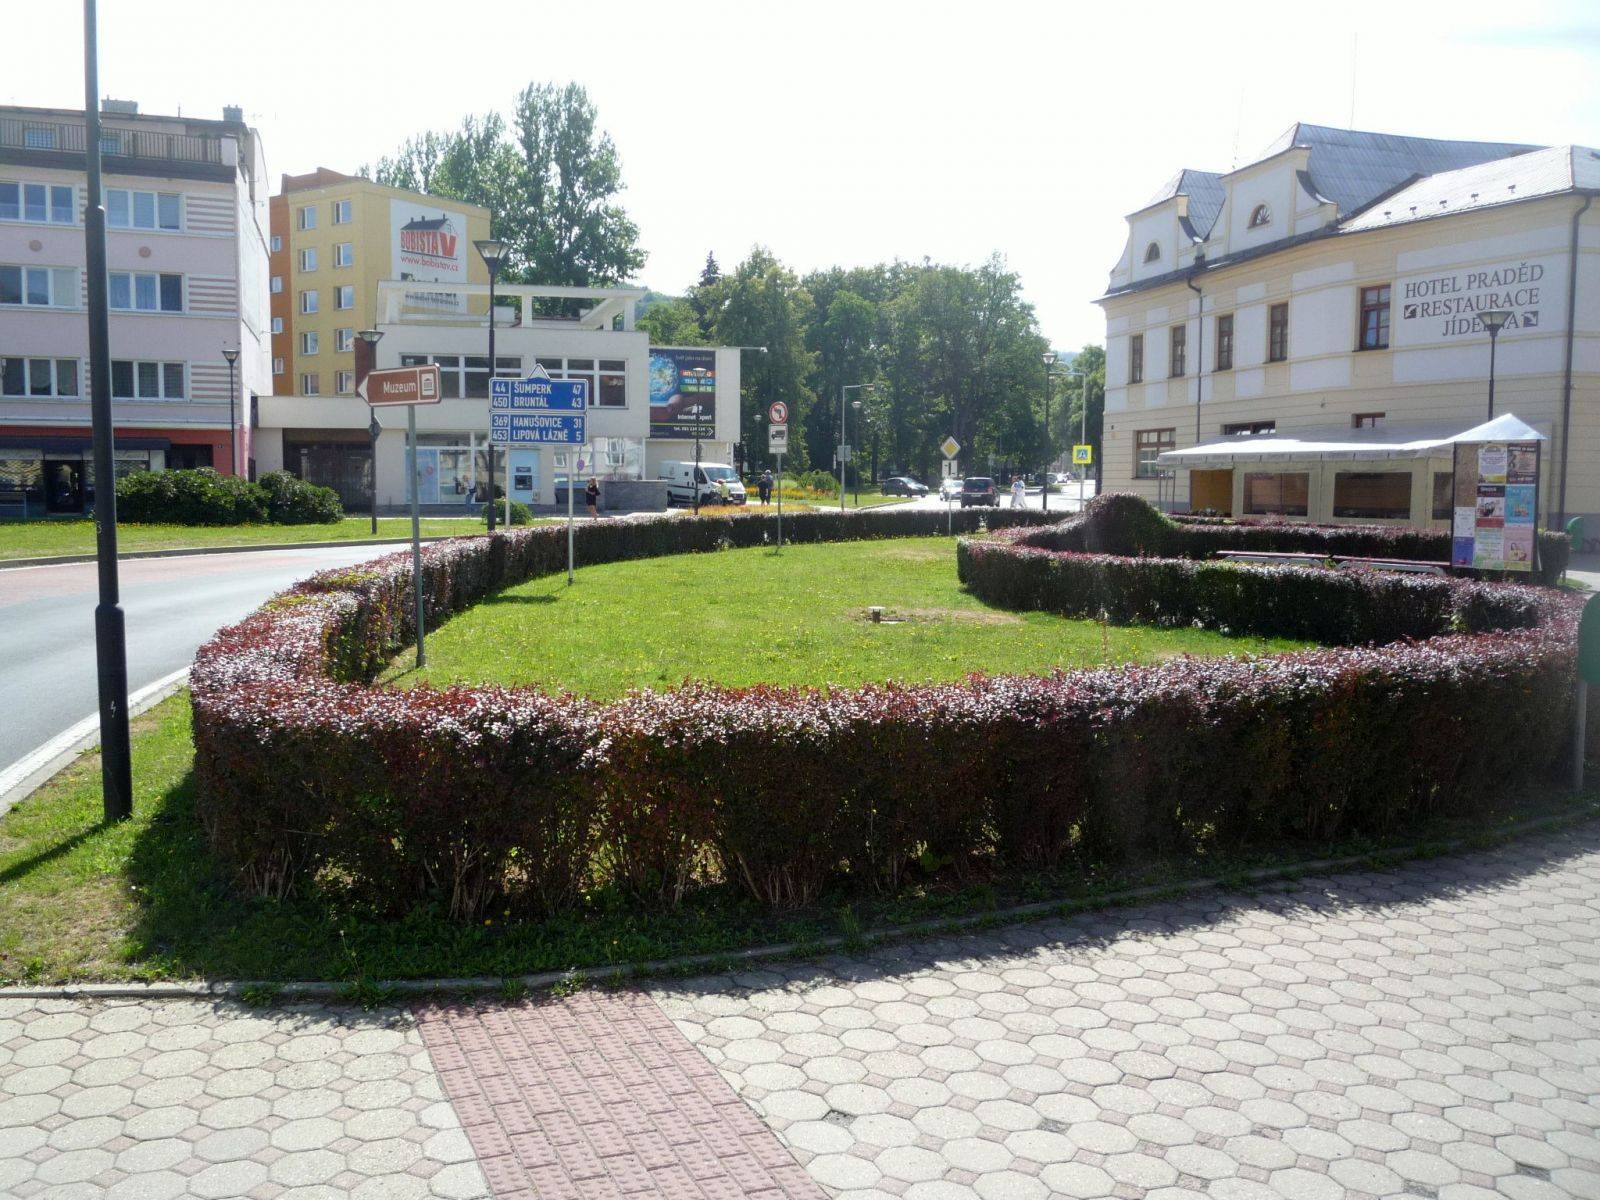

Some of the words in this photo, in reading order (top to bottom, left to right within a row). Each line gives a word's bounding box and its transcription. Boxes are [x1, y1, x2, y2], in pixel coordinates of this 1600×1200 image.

[401, 230, 456, 257] BOBISTAV
[1404, 276, 1462, 299] HOTEL
[1467, 262, 1544, 291] PRADĚD
[1420, 287, 1540, 318] RESTAURACE
[1442, 312, 1521, 337] JÍDEA
[383, 381, 417, 394] Muzeum
[495, 383, 506, 393] 44
[514, 382, 552, 394] ŠUMPERK
[572, 384, 582, 395] 47
[493, 396, 508, 407] 450
[513, 395, 549, 407] BRUNTÁL
[571, 397, 582, 408] 43
[493, 416, 508, 427] 369
[513, 415, 563, 428] HANUŠOVICE
[573, 418, 581, 428] 31
[492, 431, 508, 441] 453
[512, 429, 540, 441] LIPOVÁ
[543, 428, 568, 441] LÁZNĚ
[576, 431, 581, 441] 5
